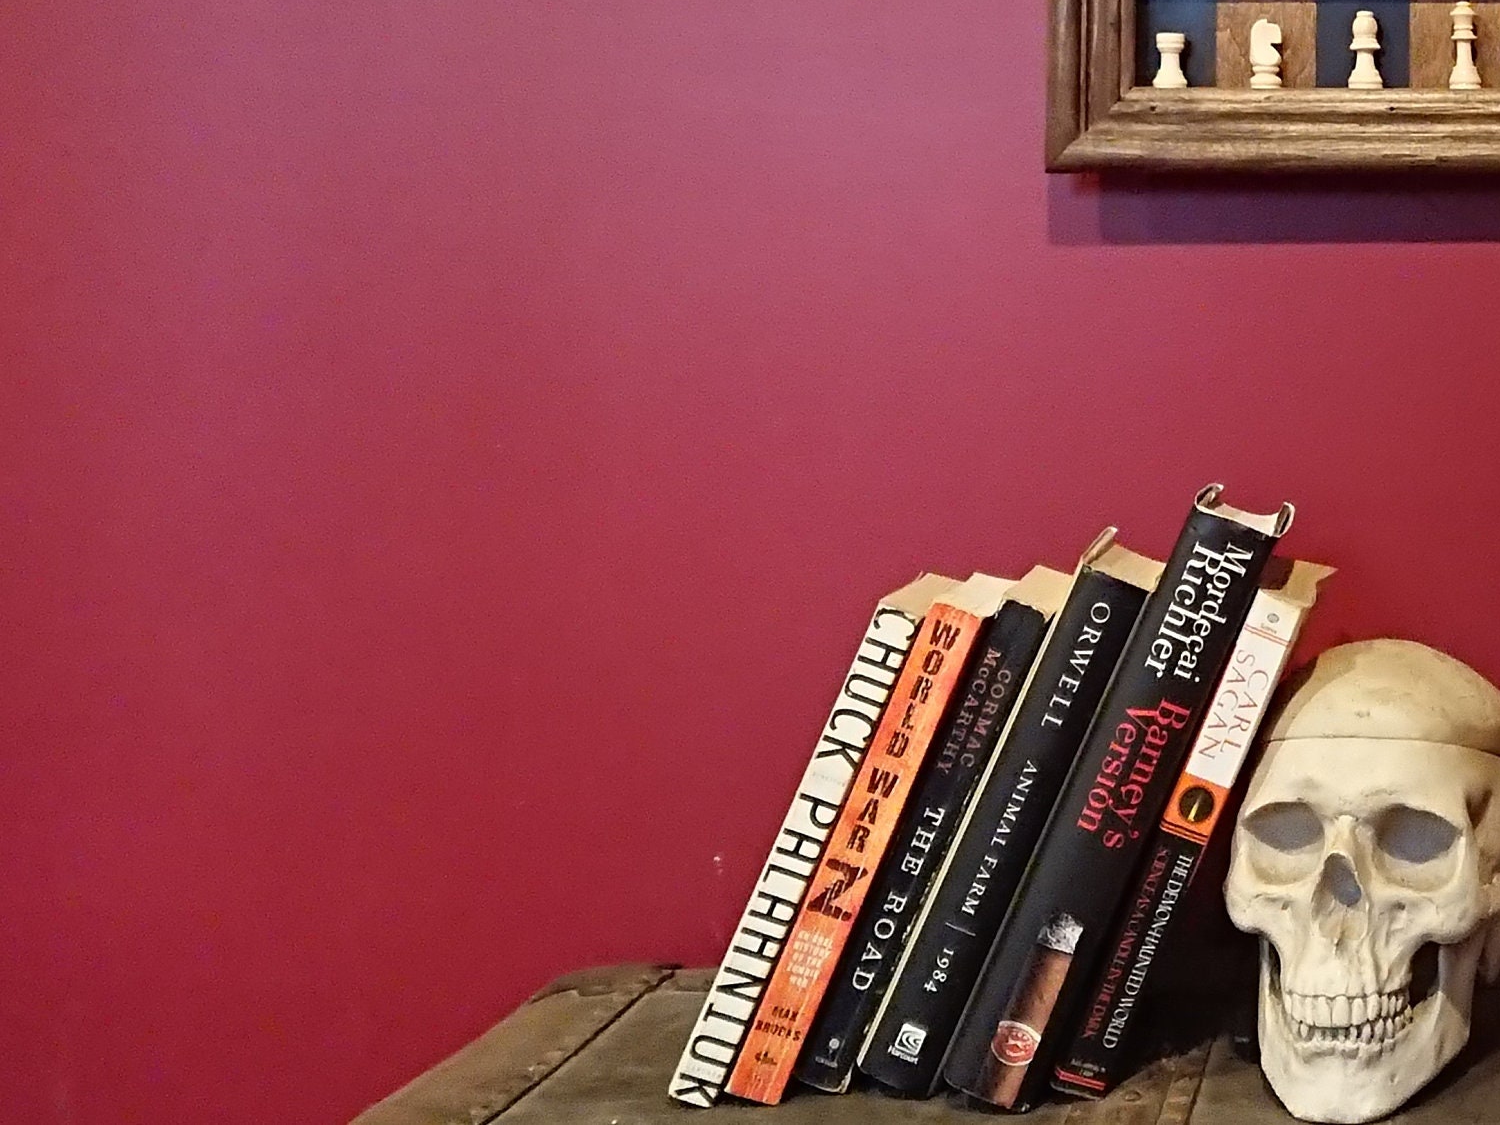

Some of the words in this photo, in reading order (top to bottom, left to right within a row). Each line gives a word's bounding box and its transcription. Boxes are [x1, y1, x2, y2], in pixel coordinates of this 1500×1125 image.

[1145, 541, 1220, 679] Richler
[1173, 542, 1254, 682] Mordecai
[816, 608, 916, 772] CHUCK
[886, 619, 960, 758] WORLD
[937, 648, 1001, 774] McCARTHY
[1040, 602, 1110, 727] ORWELL
[1198, 650, 1255, 759] SAGAN
[1220, 669, 1269, 752] CARL
[960, 669, 1011, 768] CORMAC
[846, 768, 900, 853] WAR
[991, 760, 1038, 846] ANIMAL
[1077, 706, 1158, 832] Version
[1103, 698, 1192, 849] Barney's
[807, 858, 868, 922] Z
[901, 807, 946, 875] THE
[961, 854, 998, 916] FARM
[1142, 848, 1171, 895] SCIENCE
[1172, 854, 1194, 881] THE
[674, 793, 839, 1107] PALAHNIUK
[852, 891, 907, 991] ROAD
[924, 947, 954, 993] 1984
[1103, 996, 1133, 1048] WORLD
